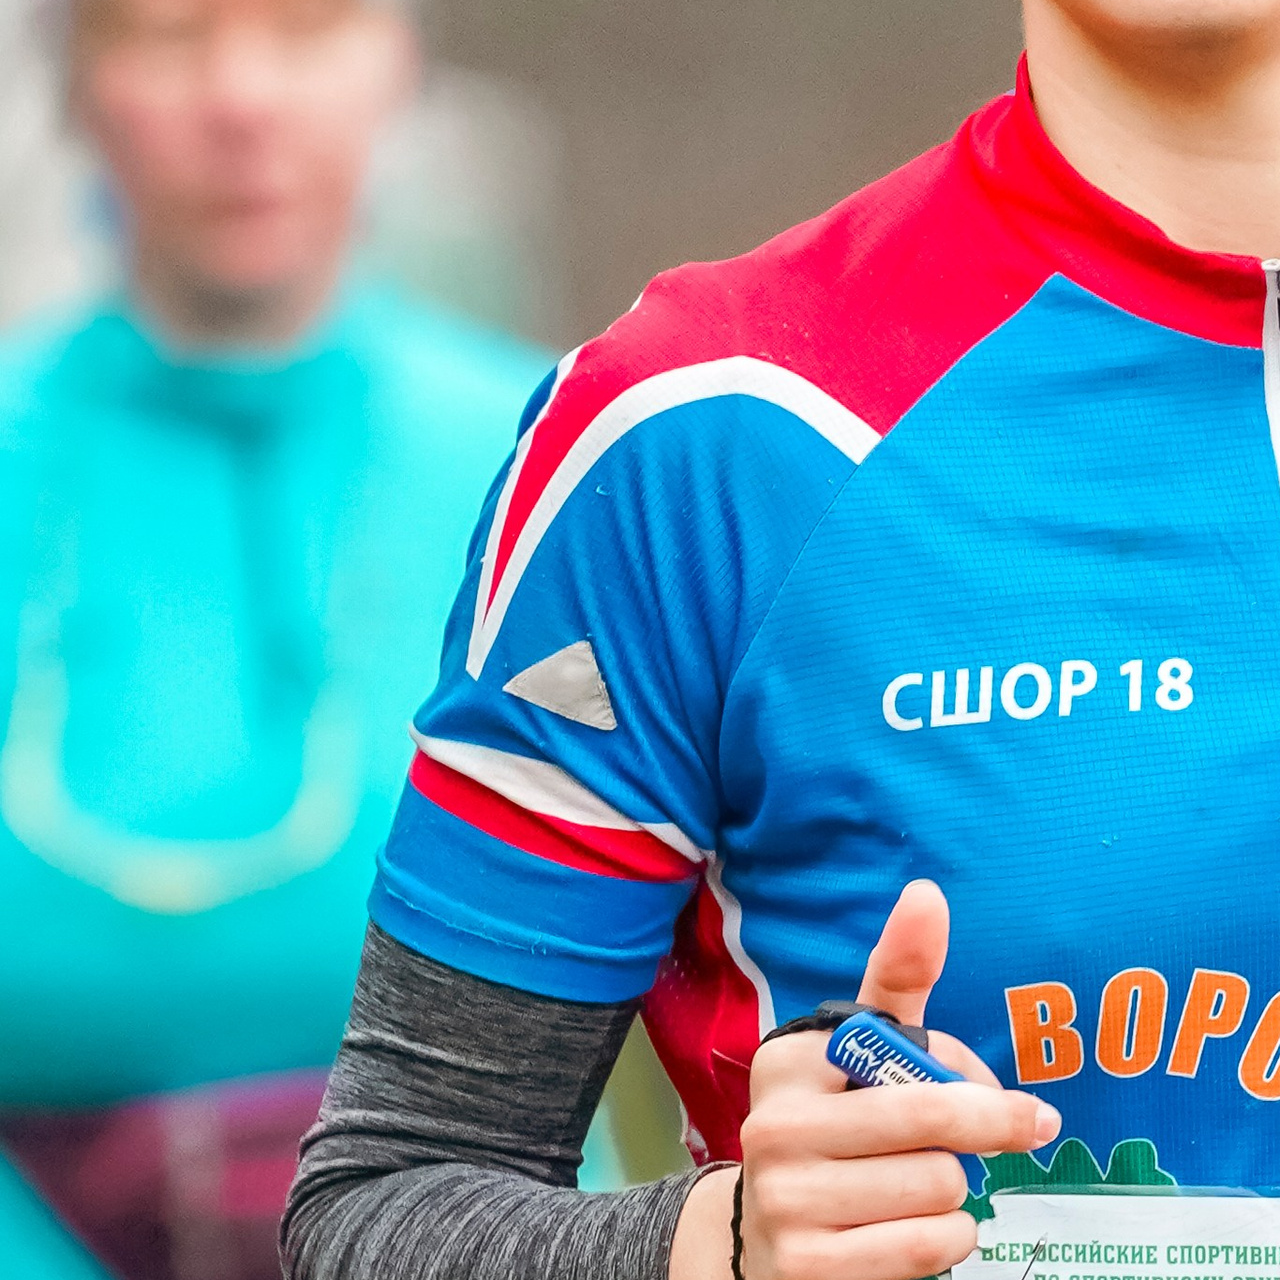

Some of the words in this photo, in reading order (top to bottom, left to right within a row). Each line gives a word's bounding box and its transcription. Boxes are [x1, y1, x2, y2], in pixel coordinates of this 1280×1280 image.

[882, 659, 1097, 731] СШОР
[1120, 657, 1194, 712] 18
[981, 1239, 1158, 1264] ВСЕРОССИЙСКИЕ
